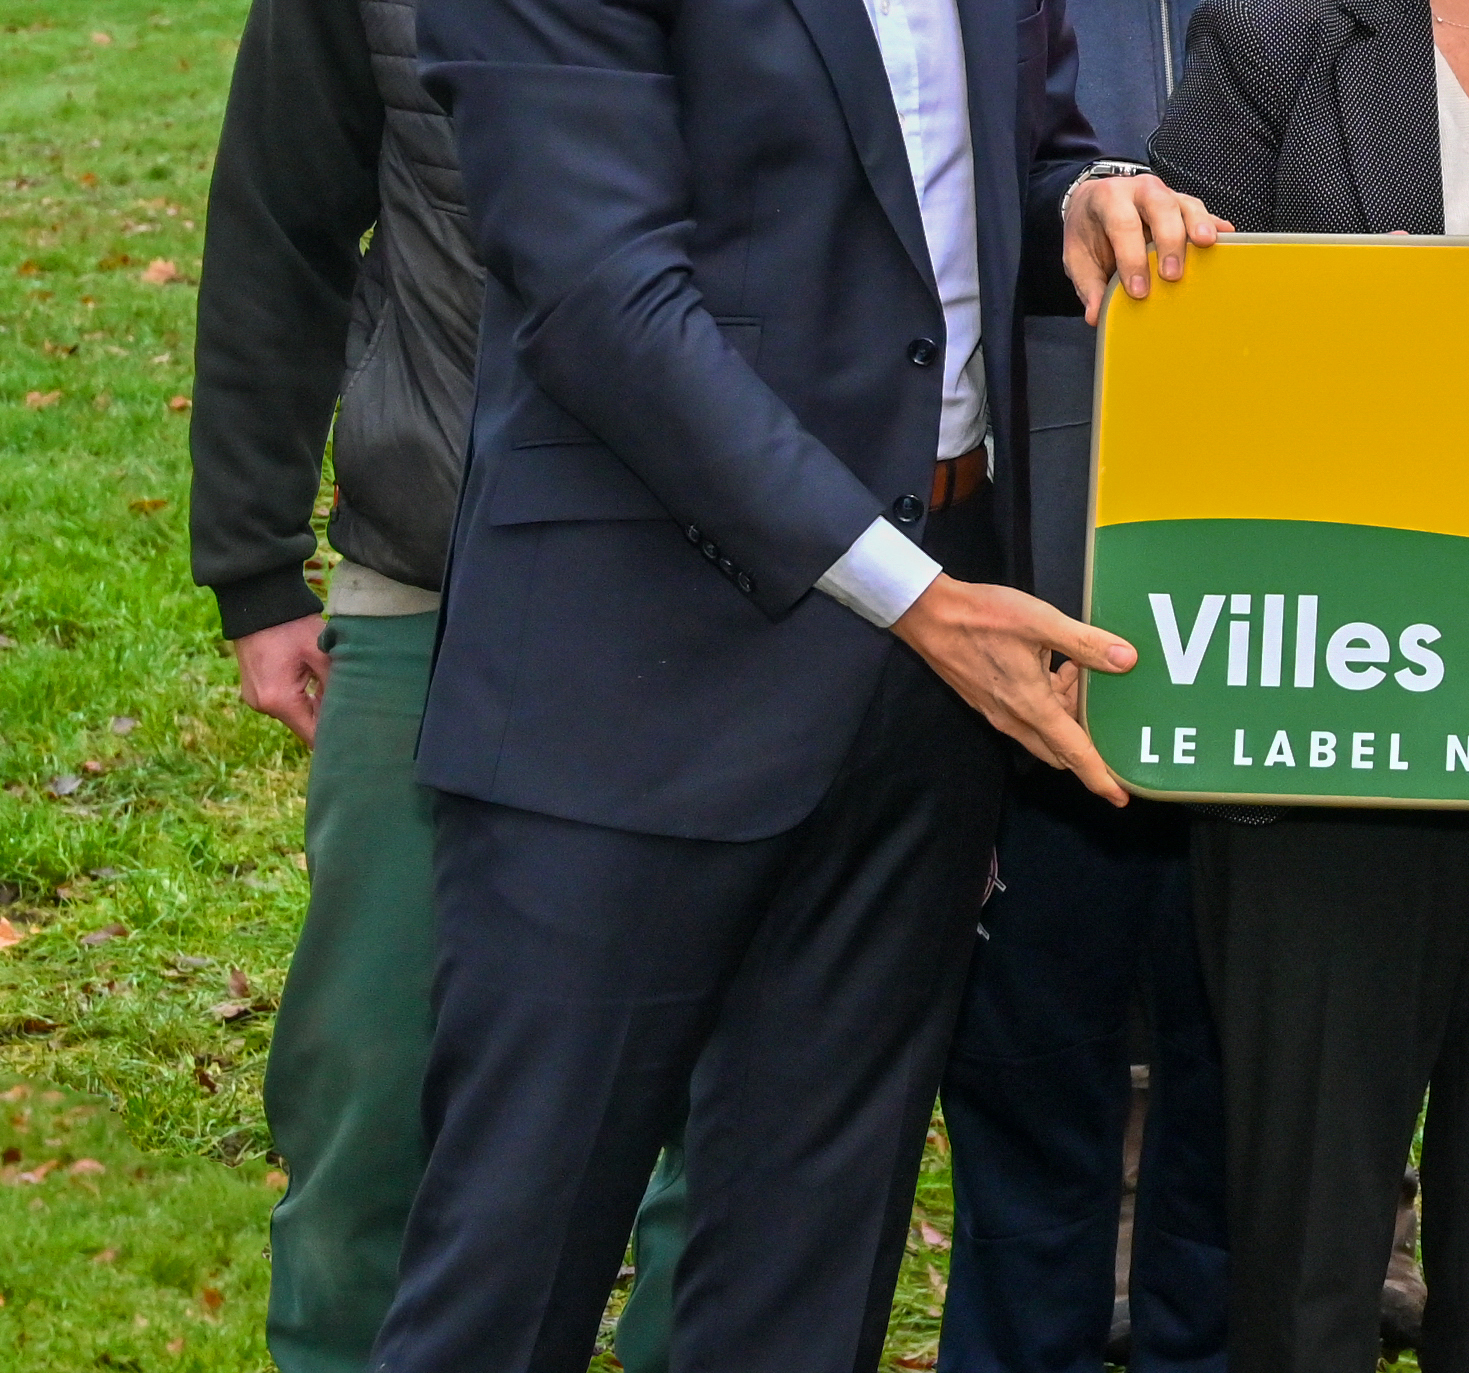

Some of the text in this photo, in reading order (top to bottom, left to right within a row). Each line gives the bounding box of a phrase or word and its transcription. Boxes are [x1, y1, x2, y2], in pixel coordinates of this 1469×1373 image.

[1148, 592, 1444, 692] Villes
[1140, 726, 1197, 765] LE
[1233, 728, 1409, 771] LABEL
